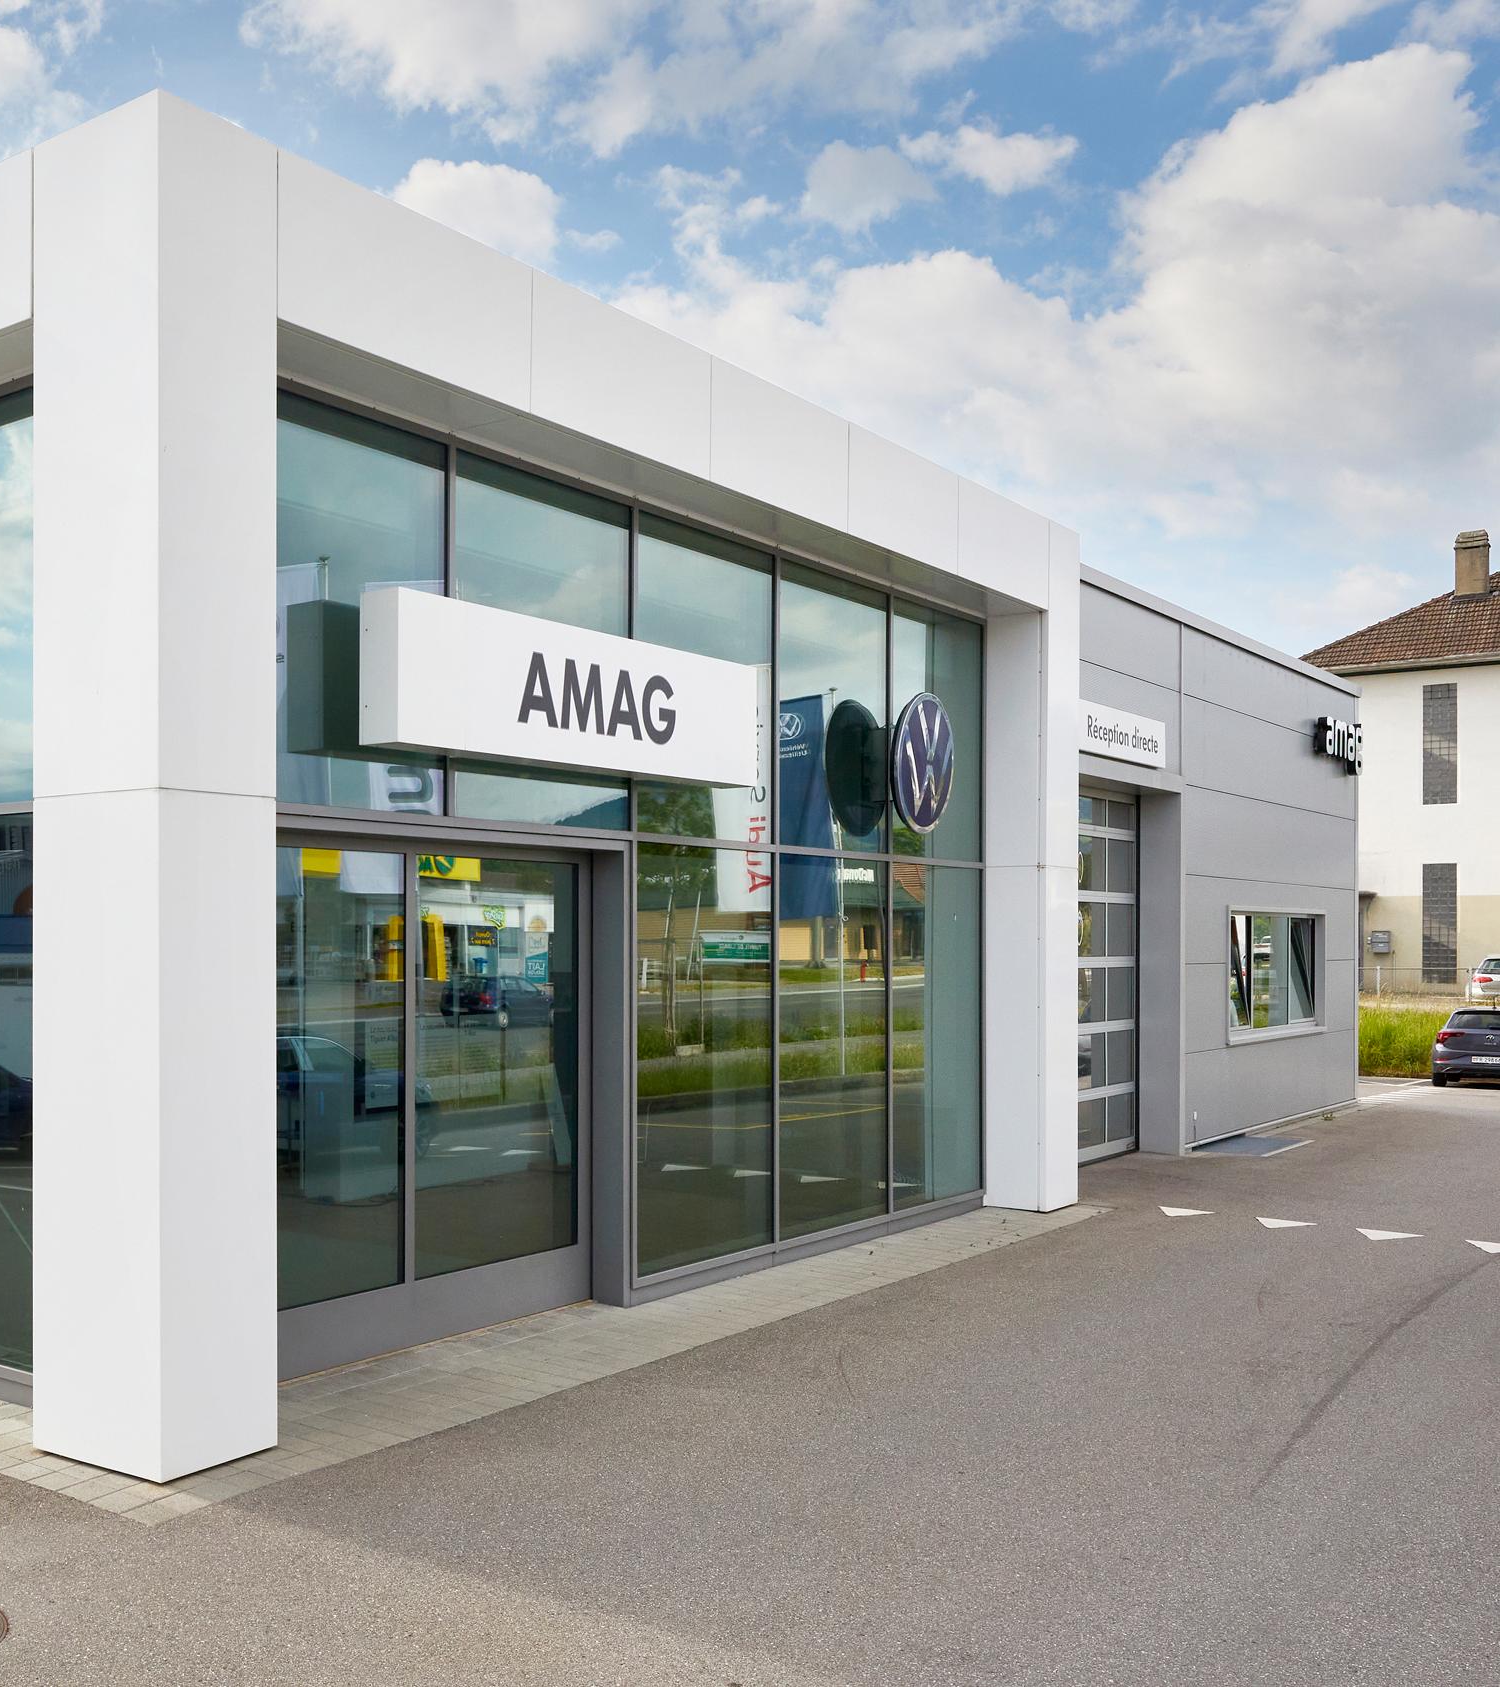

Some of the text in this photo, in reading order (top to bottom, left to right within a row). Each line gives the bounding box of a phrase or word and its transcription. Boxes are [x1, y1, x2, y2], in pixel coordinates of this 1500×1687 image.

[517, 651, 677, 746] AMAG
[1087, 714, 1159, 754] Réception directe
[1324, 715, 1364, 777] amag
